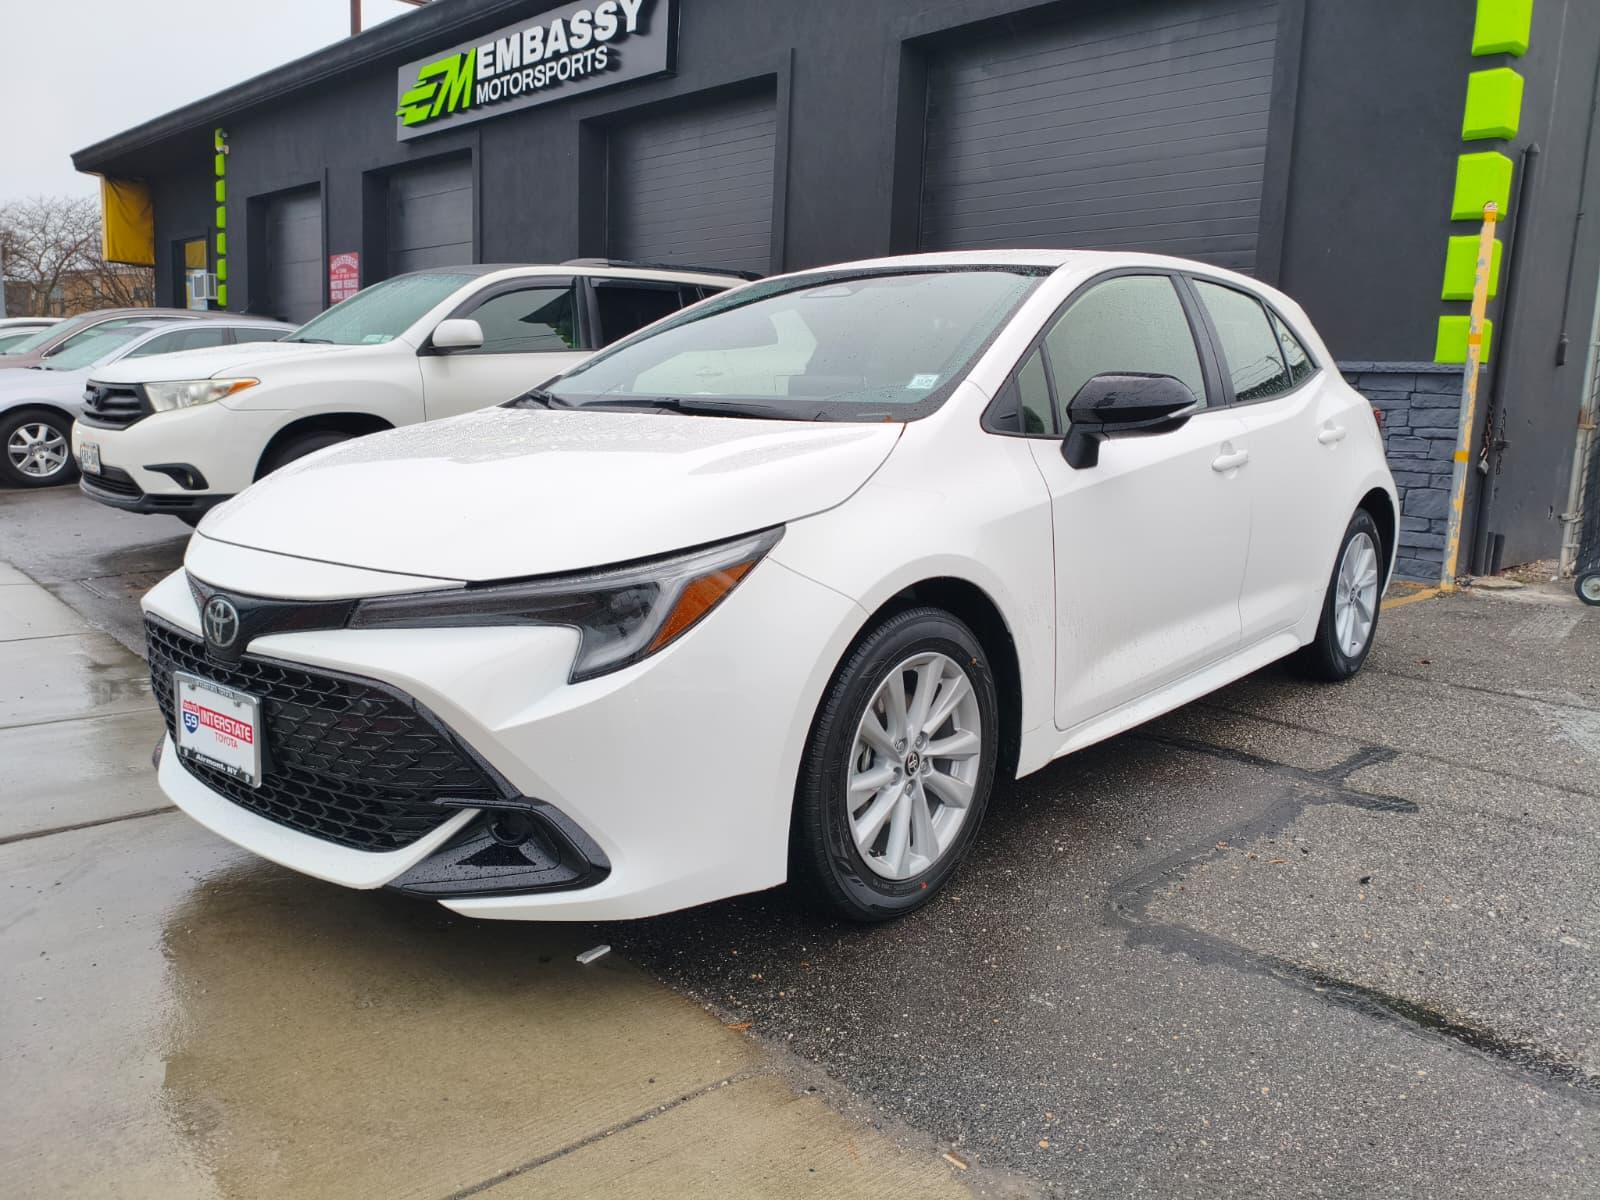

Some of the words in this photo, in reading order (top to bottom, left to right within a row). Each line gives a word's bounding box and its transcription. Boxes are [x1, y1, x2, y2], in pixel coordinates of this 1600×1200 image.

[476, 0, 641, 80] EMBASSY
[476, 46, 608, 104] MOTORSPORTS
[185, 714, 197, 728] 59
[200, 709, 252, 742] INTERSTATE
[215, 732, 238, 748] TOYOTA
